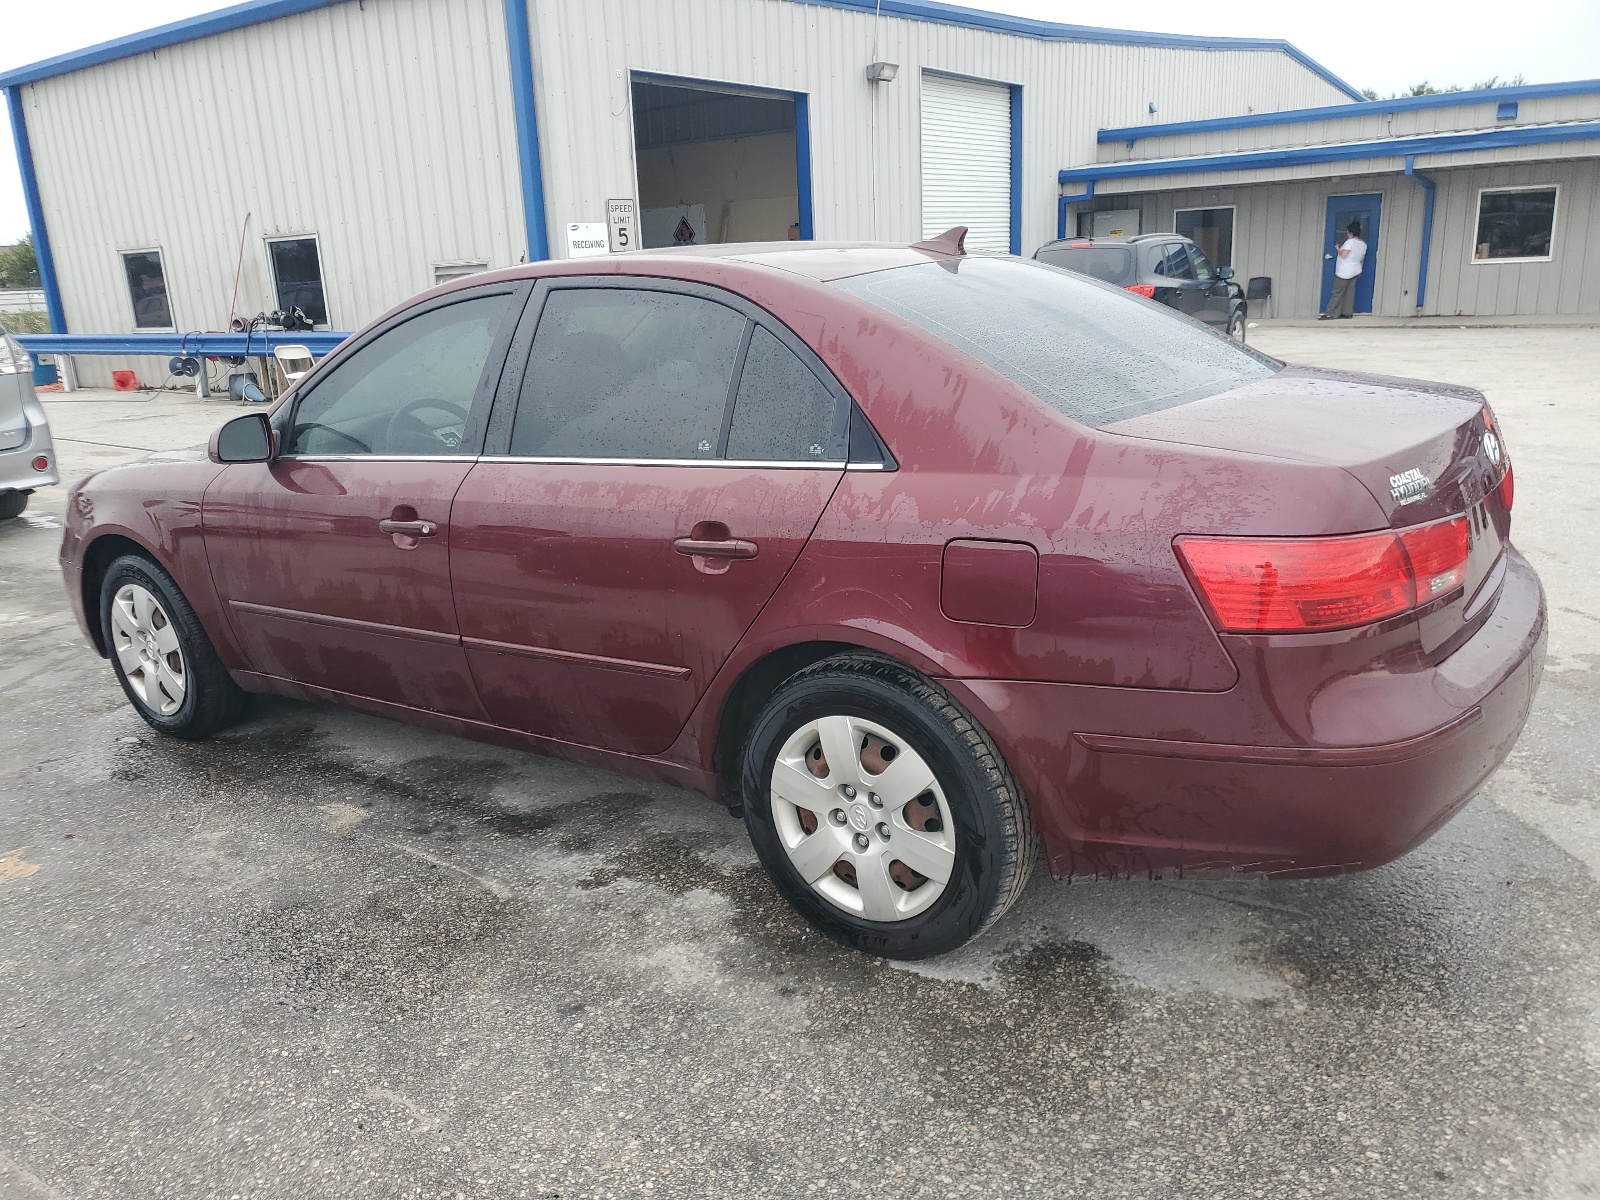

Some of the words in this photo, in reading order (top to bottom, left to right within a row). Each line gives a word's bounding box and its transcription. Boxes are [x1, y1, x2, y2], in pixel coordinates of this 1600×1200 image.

[610, 204, 633, 213] SPEED
[613, 216, 631, 224] LIMIT
[572, 239, 605, 249] RECEIVING
[618, 227, 629, 247] 5
[1389, 467, 1424, 488] COASTAL
[1389, 476, 1430, 501] HYUNDAI
